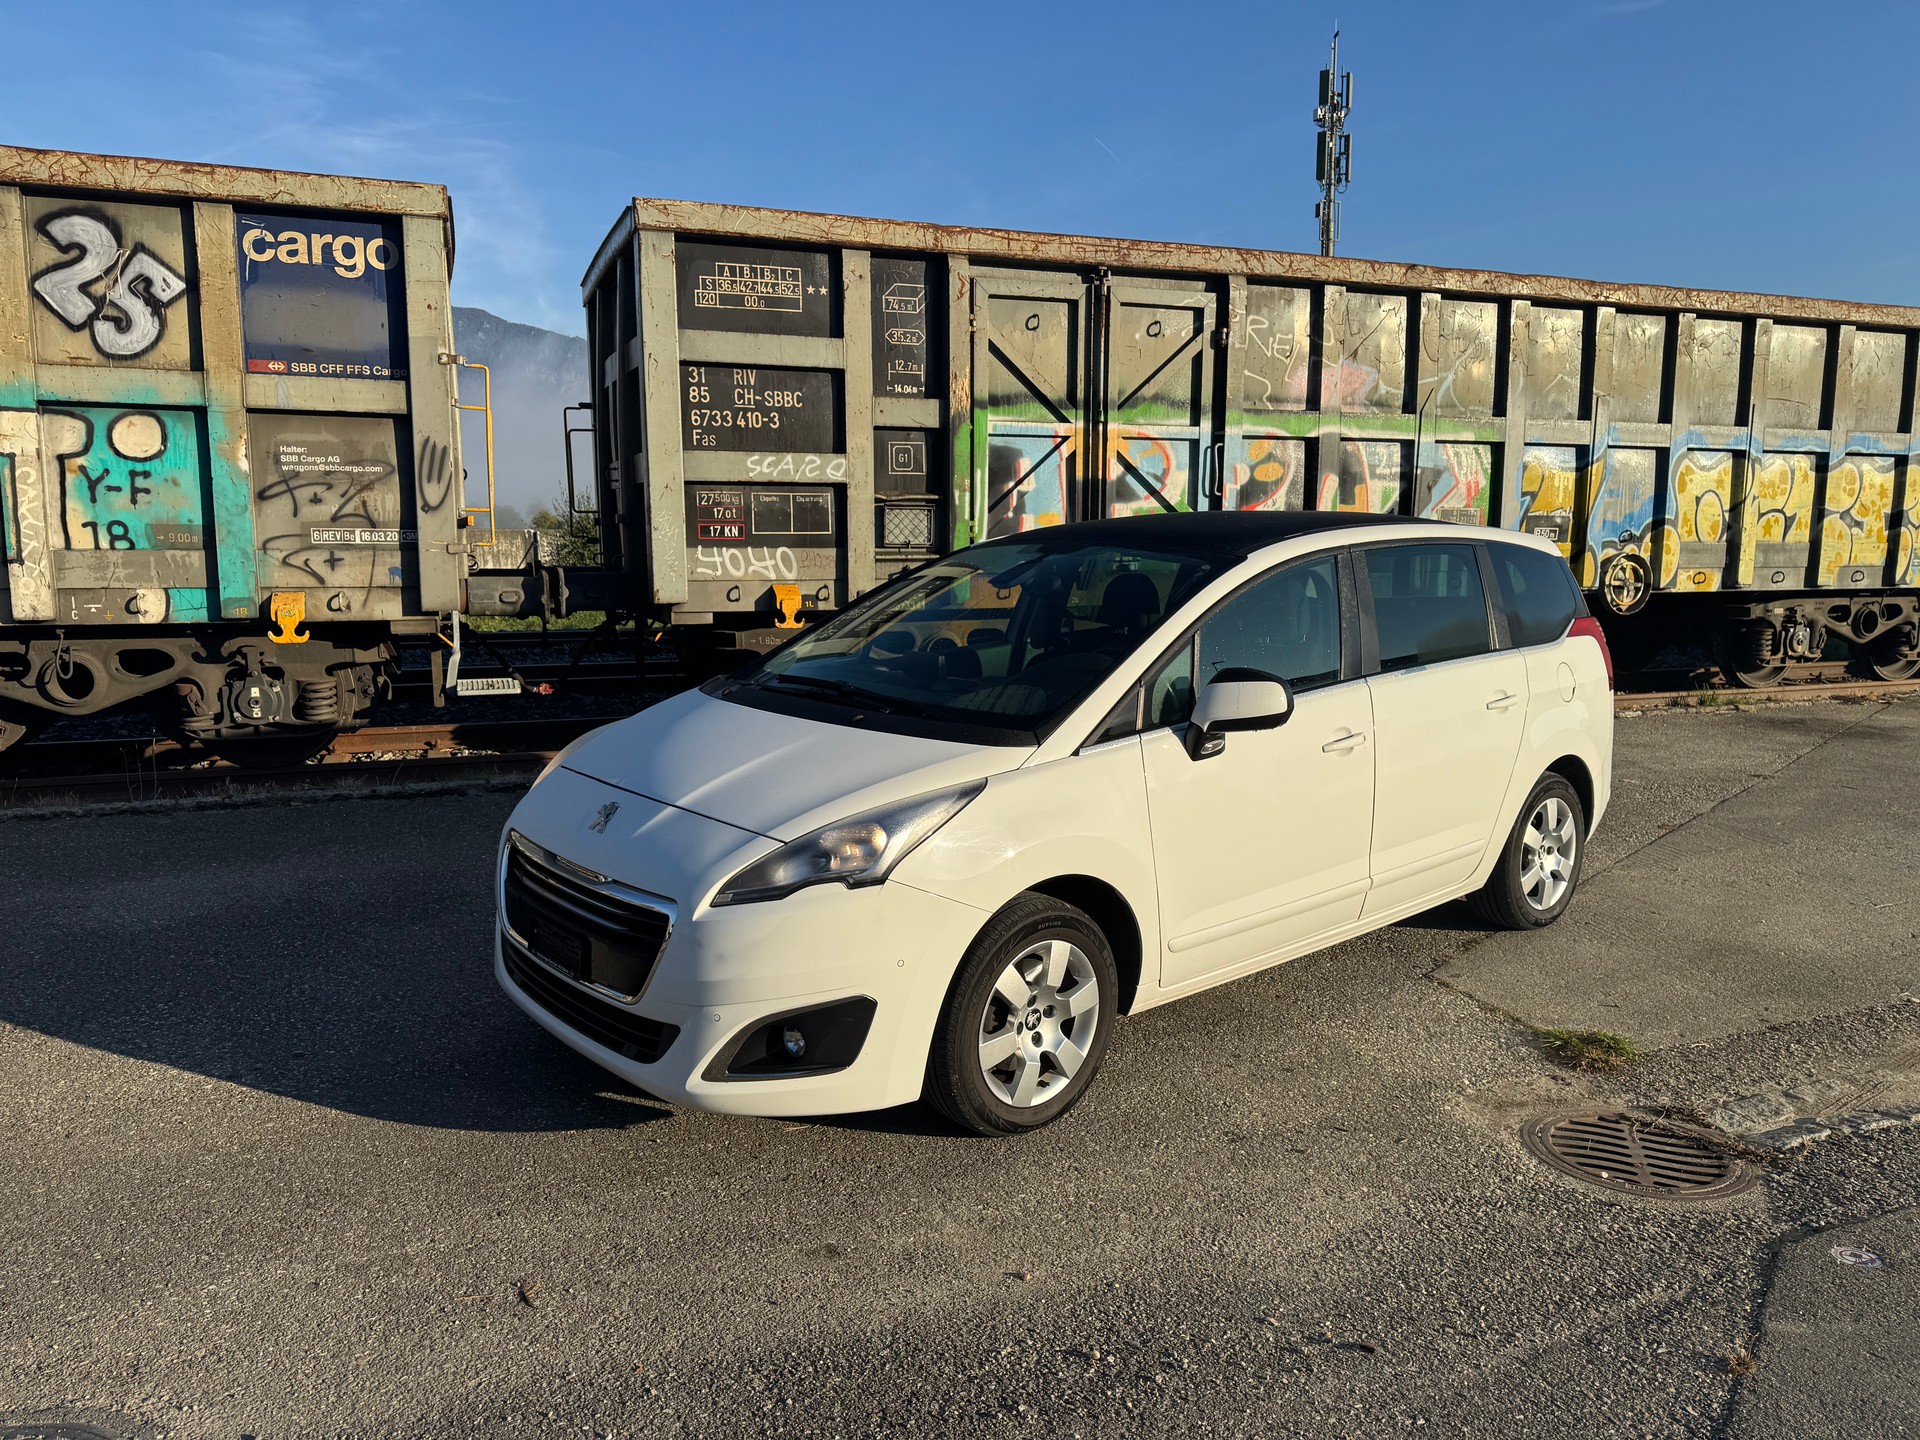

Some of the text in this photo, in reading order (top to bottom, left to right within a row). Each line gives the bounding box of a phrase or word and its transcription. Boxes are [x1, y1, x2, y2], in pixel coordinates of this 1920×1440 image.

[242, 228, 399, 279] cargo
[723, 266, 730, 277] A
[786, 270, 793, 281] C
[706, 279, 800, 295] S 36.5 42.7 44.5 52.5
[698, 293, 765, 307] 120 00.0
[291, 363, 407, 378] SBB CFF FFS Cargo
[688, 367, 756, 385] 31 RIV
[689, 386, 803, 408] 85 CH-SBBC
[691, 410, 780, 428] 6733 410-3
[692, 429, 716, 446] Fas
[300, 455, 326, 464] Cargo
[281, 464, 383, 473] waggons@sbbcargo.com
[313, 531, 320, 541] 6
[323, 531, 341, 541] REV
[361, 531, 399, 541] 16.03.20
[709, 526, 739, 538] 17 KN
[805, 600, 814, 608] 1L
